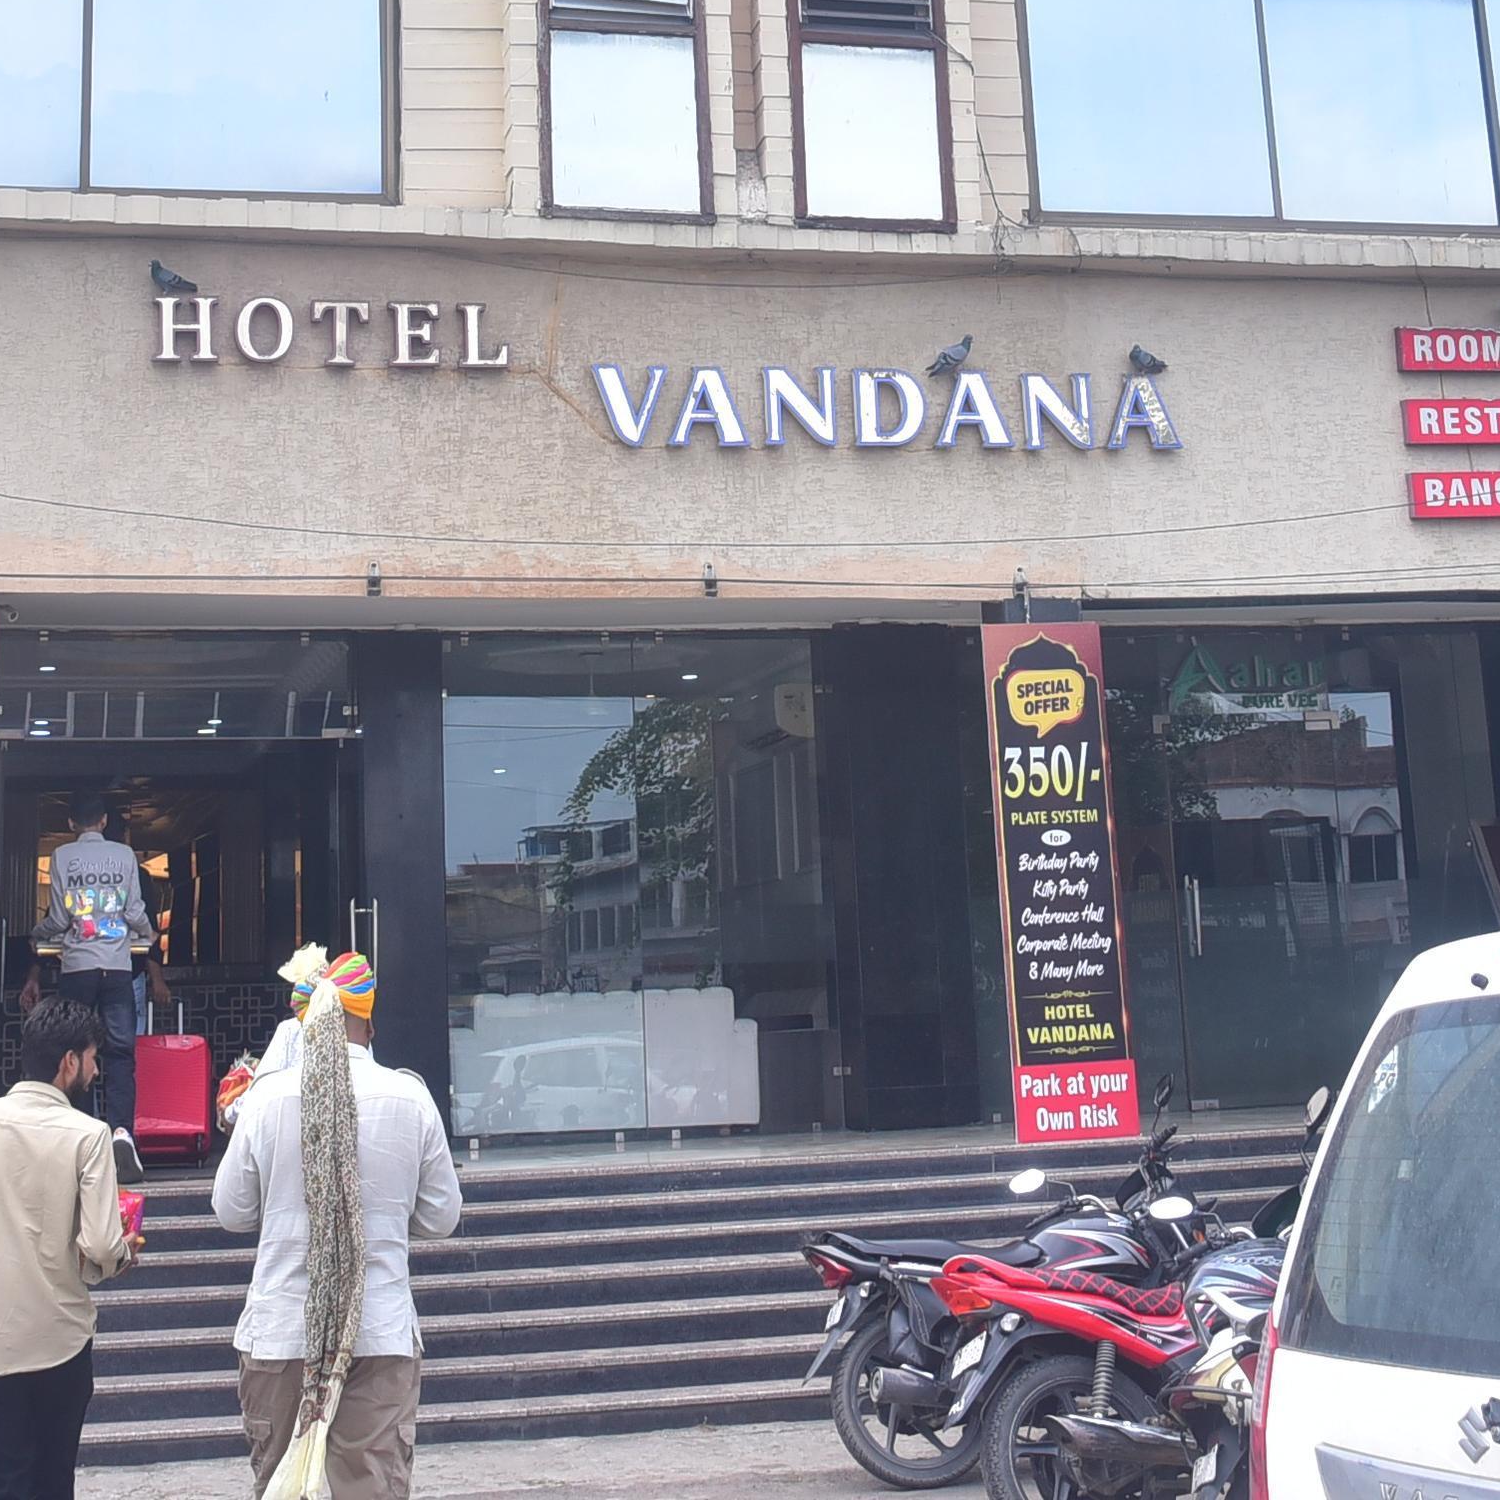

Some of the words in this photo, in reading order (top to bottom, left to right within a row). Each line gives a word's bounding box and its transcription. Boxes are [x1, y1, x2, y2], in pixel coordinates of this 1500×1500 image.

[151, 295, 510, 368] HOTEL
[590, 363, 1185, 451] VANDANA
[1017, 678, 1073, 698] SPECIAL
[1024, 697, 1069, 716] OFFER
[1242, 695, 1284, 709] PURE
[1288, 693, 1318, 708] VEG
[1004, 742, 1100, 801] 350/-
[1011, 811, 1048, 825] PLATE
[1051, 809, 1098, 823] SYSTEM
[1050, 833, 1063, 843] for
[1018, 852, 1068, 873] Birthday
[1070, 850, 1099, 873] Party
[68, 873, 123, 887] MOOD
[1033, 879, 1057, 900] Kitty
[1059, 878, 1089, 900] Party
[1021, 907, 1079, 927] Conference
[1081, 903, 1103, 923] Hall
[1017, 934, 1069, 954] Corporate
[1070, 932, 1112, 954] Meeting
[1029, 962, 1038, 980] &
[1040, 961, 1072, 982] Many
[1074, 960, 1104, 977] More
[1044, 1004, 1094, 1021] HOTEL
[1027, 1023, 1114, 1045] VANDANA
[1020, 1073, 1061, 1097] Park
[1067, 1073, 1084, 1094] at
[1090, 1073, 1128, 1098] your
[1036, 1107, 1074, 1131] Own
[1080, 1103, 1118, 1129] Risk
